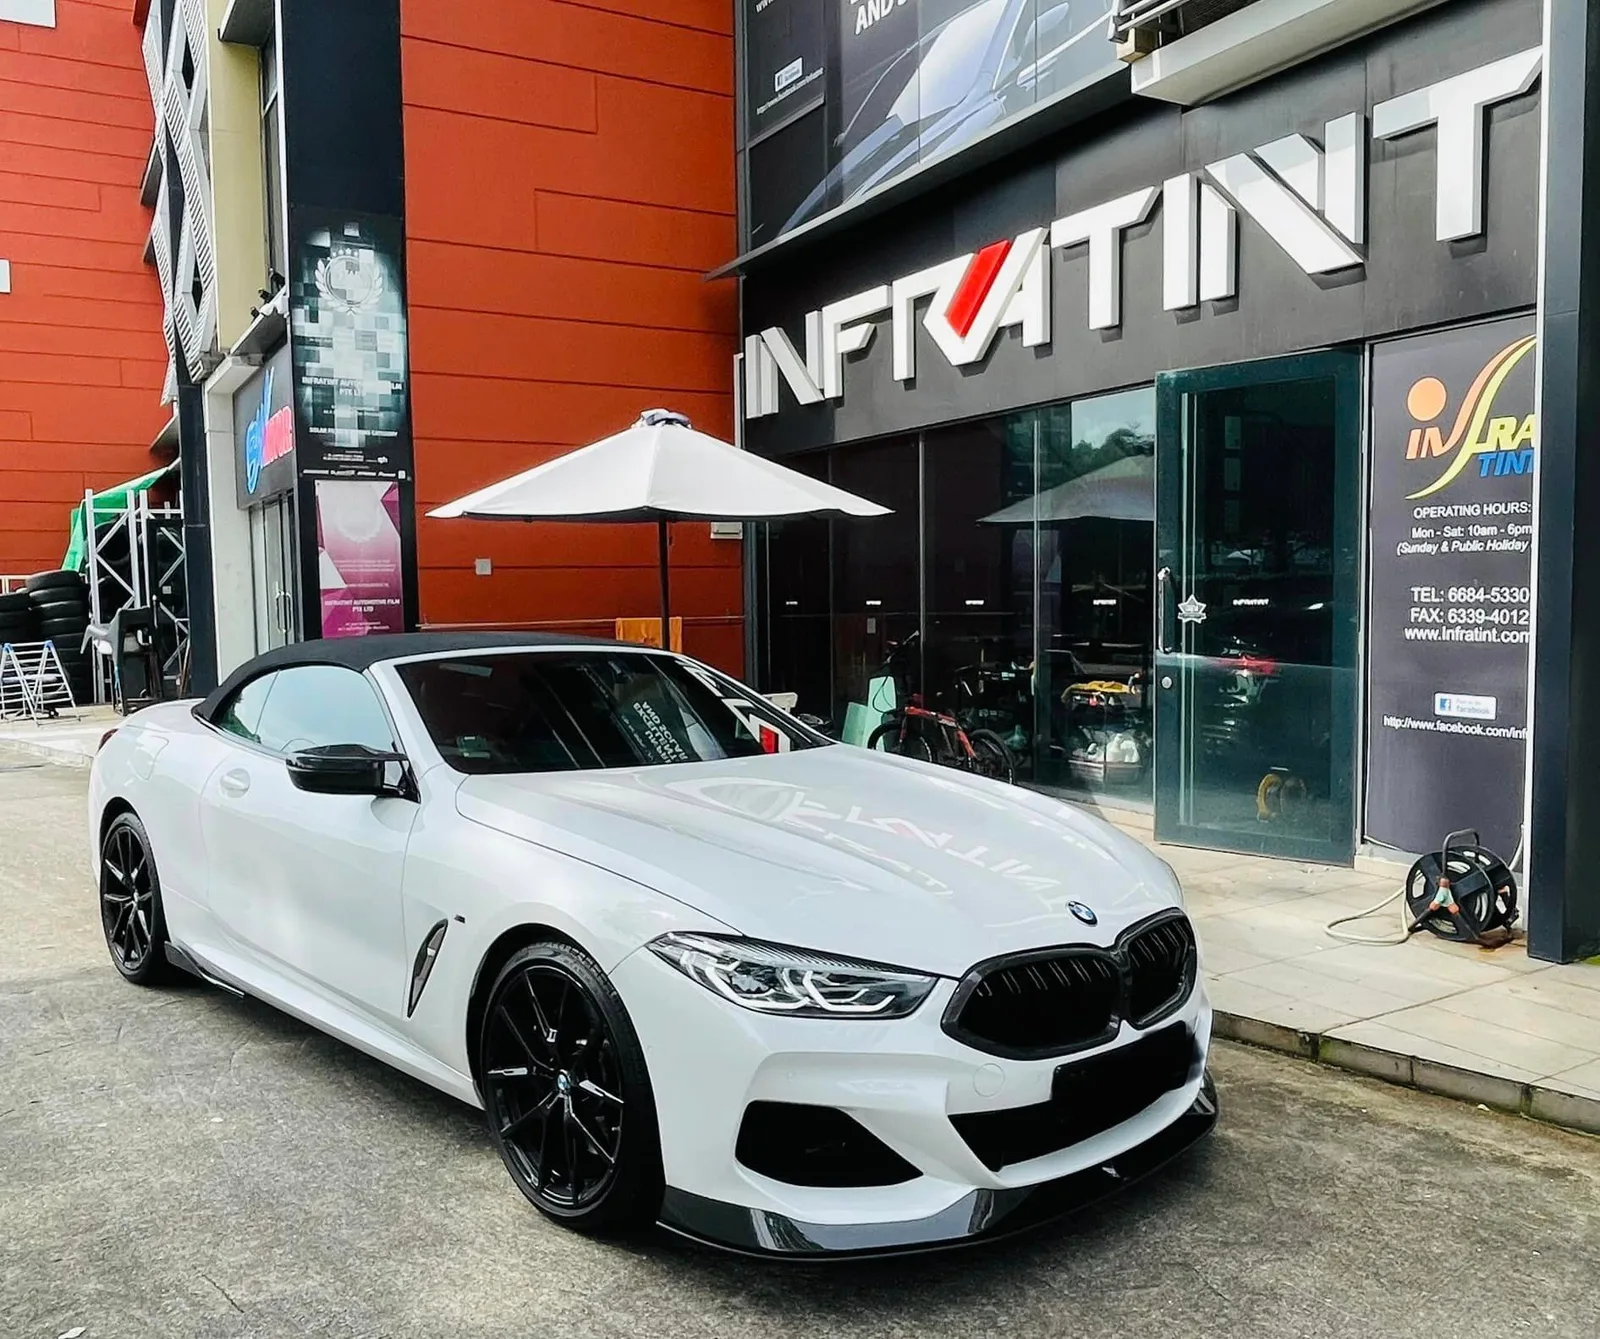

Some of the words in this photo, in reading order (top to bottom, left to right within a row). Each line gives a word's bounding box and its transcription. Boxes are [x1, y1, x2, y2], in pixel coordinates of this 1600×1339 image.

[855, 0, 894, 35] AND
[745, 46, 1543, 418] INFRATINT
[1413, 504, 1481, 519] OPERATING
[1483, 502, 1532, 516] HOURS:
[1411, 527, 1435, 539] Mon
[1443, 526, 1465, 538] Sat:
[1467, 524, 1498, 537] 10am
[1397, 541, 1440, 556] (Sunday
[1441, 541, 1450, 553] &
[1451, 540, 1485, 553] Public
[1486, 539, 1530, 553] Holiday
[1410, 587, 1445, 603] TEL:
[1447, 587, 1530, 604] 6684-5330
[1410, 607, 1445, 623] FAX:
[1447, 608, 1530, 625] 6339-4012
